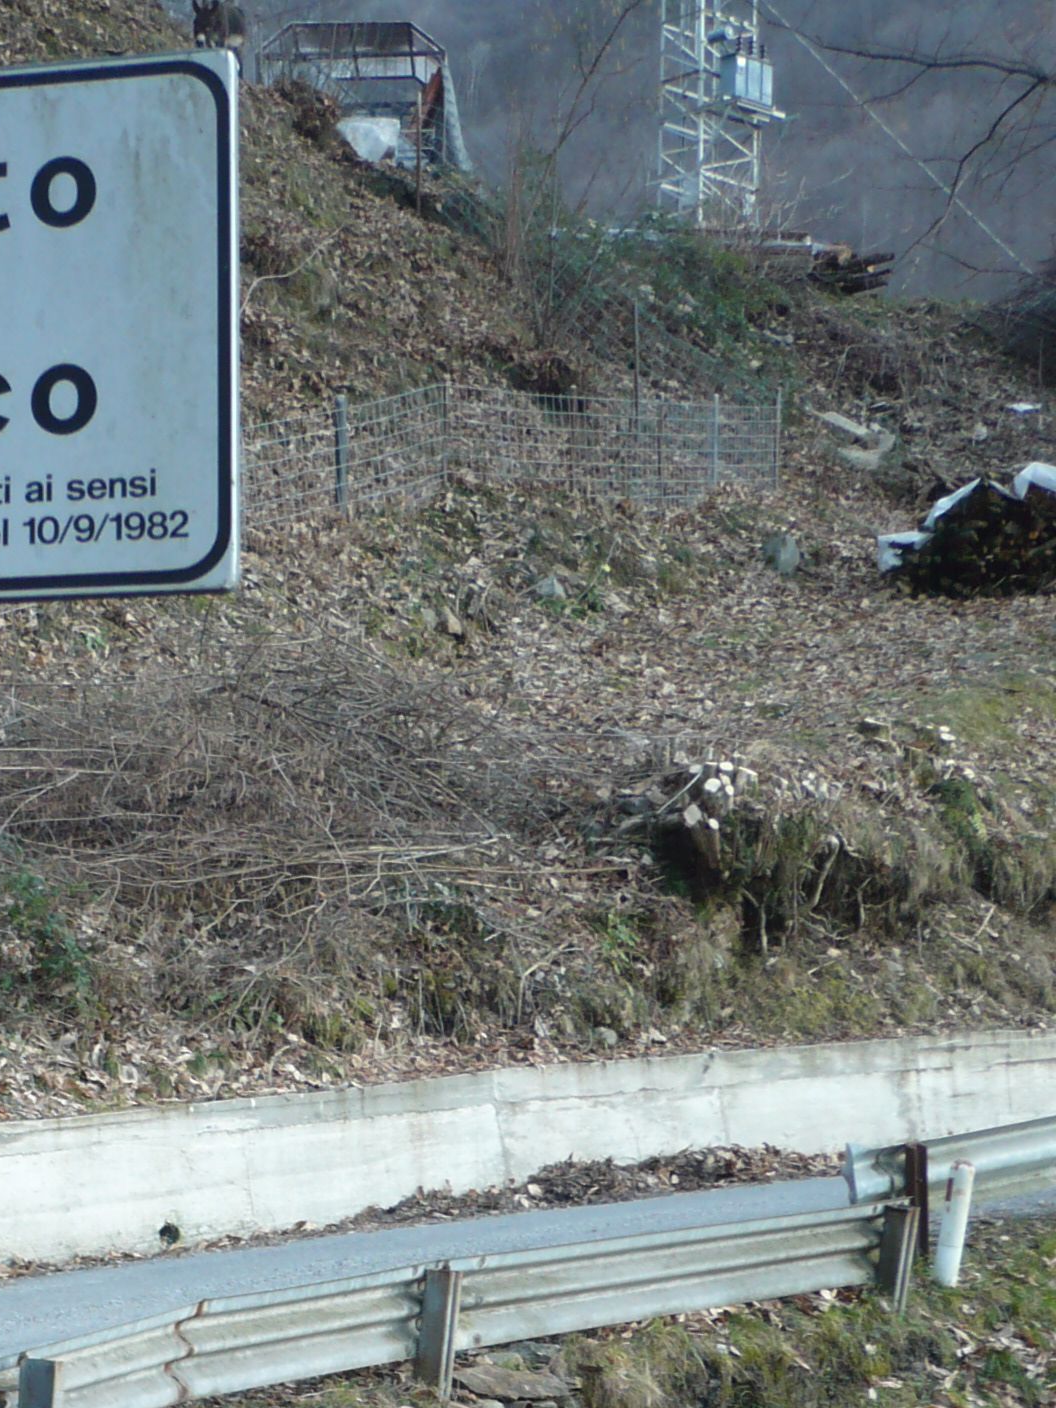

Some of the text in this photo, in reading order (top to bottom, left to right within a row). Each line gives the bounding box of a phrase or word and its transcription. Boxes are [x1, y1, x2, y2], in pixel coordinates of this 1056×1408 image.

[24, 473, 53, 503] ai
[66, 468, 157, 501] sensi
[23, 510, 189, 545] 10/9/1982
